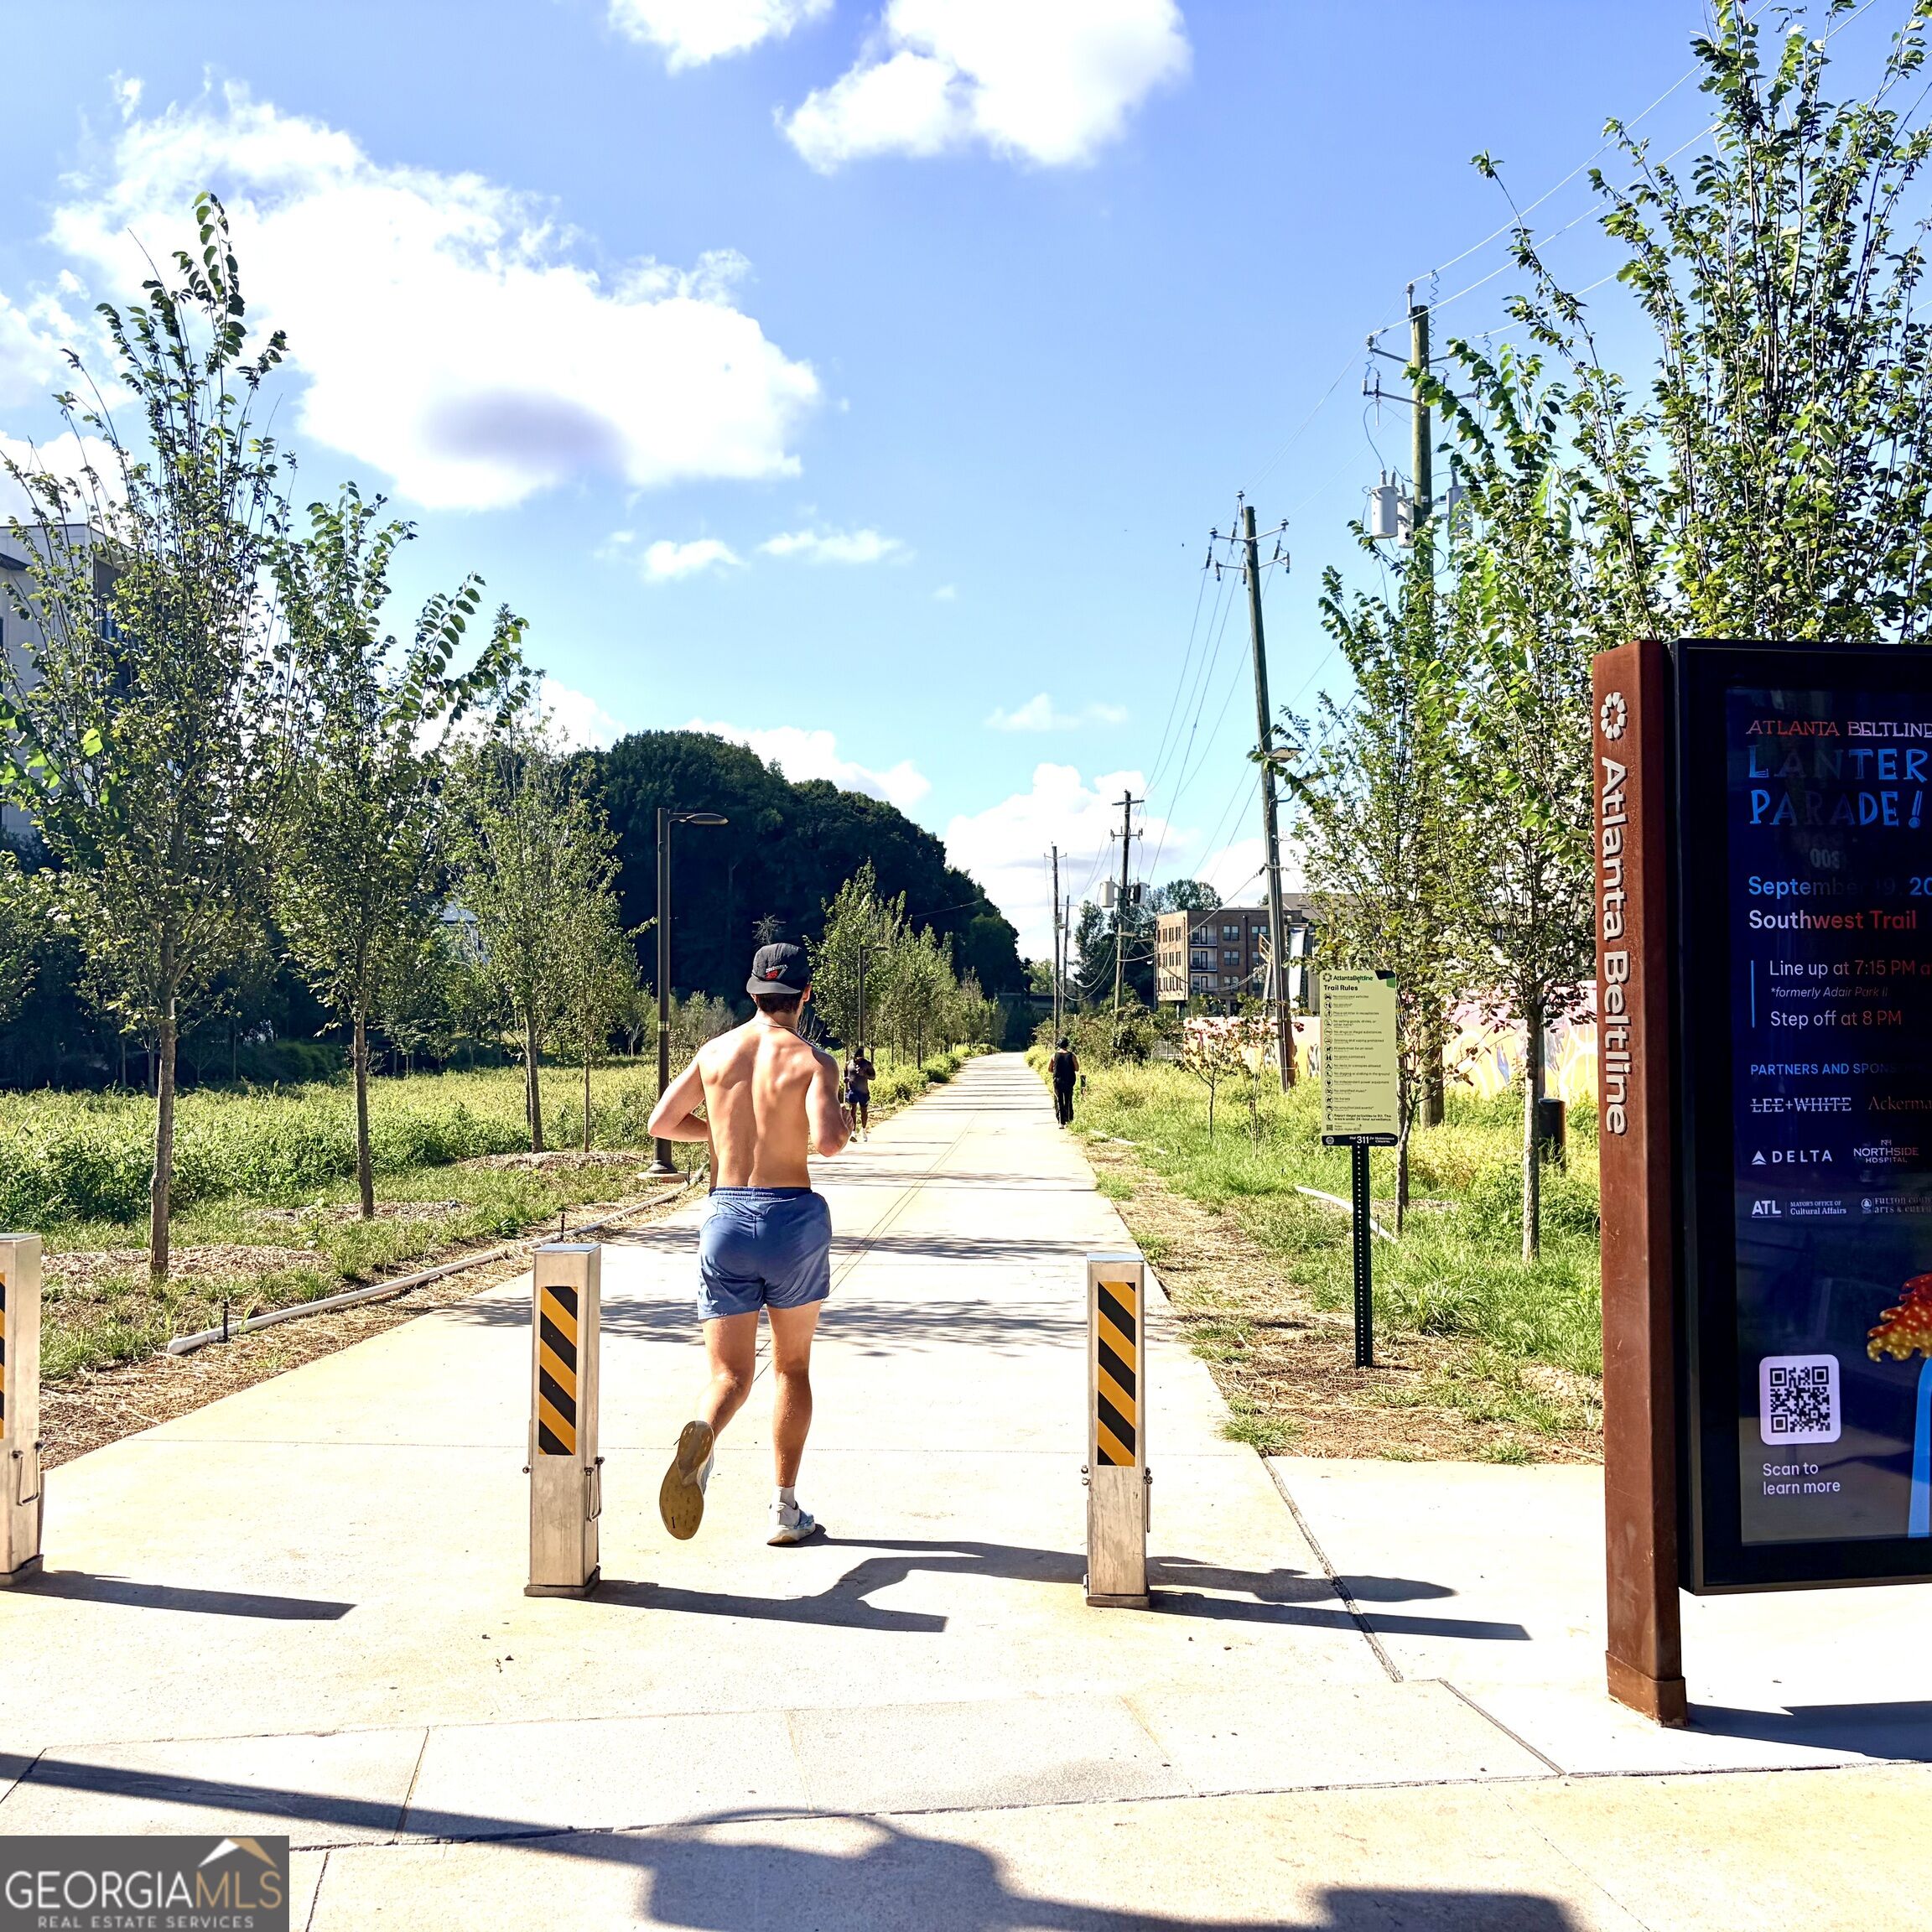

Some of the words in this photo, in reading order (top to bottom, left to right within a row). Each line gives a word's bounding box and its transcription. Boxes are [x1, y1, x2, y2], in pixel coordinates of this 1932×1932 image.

[1745, 719, 1841, 736] ATLANTA
[1847, 721, 1932, 738] BELTLINE
[1747, 745, 1928, 782] LANTER
[1750, 789, 1923, 828] PARADE!
[1602, 756, 1628, 941] Atlanta
[1749, 910, 1863, 929] Southwest
[1868, 910, 1917, 929] Trail
[1769, 960, 1803, 975] Line
[1808, 963, 1828, 979] up
[1833, 962, 1850, 975] at
[1854, 960, 1886, 975] 7:15
[1891, 960, 1915, 975] PM
[1823, 986, 1852, 997] Adair
[1855, 986, 1878, 997] Park
[1770, 1011, 1809, 1030] Step
[1814, 1010, 1836, 1026] off
[1841, 1012, 1857, 1026] at
[1862, 1011, 1872, 1025] 8
[1877, 1010, 1903, 1025] PM
[1603, 951, 1631, 1135] Beltline
[1751, 1063, 1818, 1075] PARTNERS
[1822, 1063, 1849, 1075] AND
[1750, 1097, 1852, 1113] LEE+WHITE
[1357, 1135, 1369, 1144] 311
[1772, 1150, 1833, 1163] DELTA
[1853, 1147, 1919, 1156] NORTHSIDE
[1752, 1200, 1782, 1215] ATL
[1763, 1463, 1800, 1477] Scan
[1803, 1462, 1819, 1475] to
[1763, 1481, 1800, 1495] learn
[1804, 1481, 1841, 1493] more
